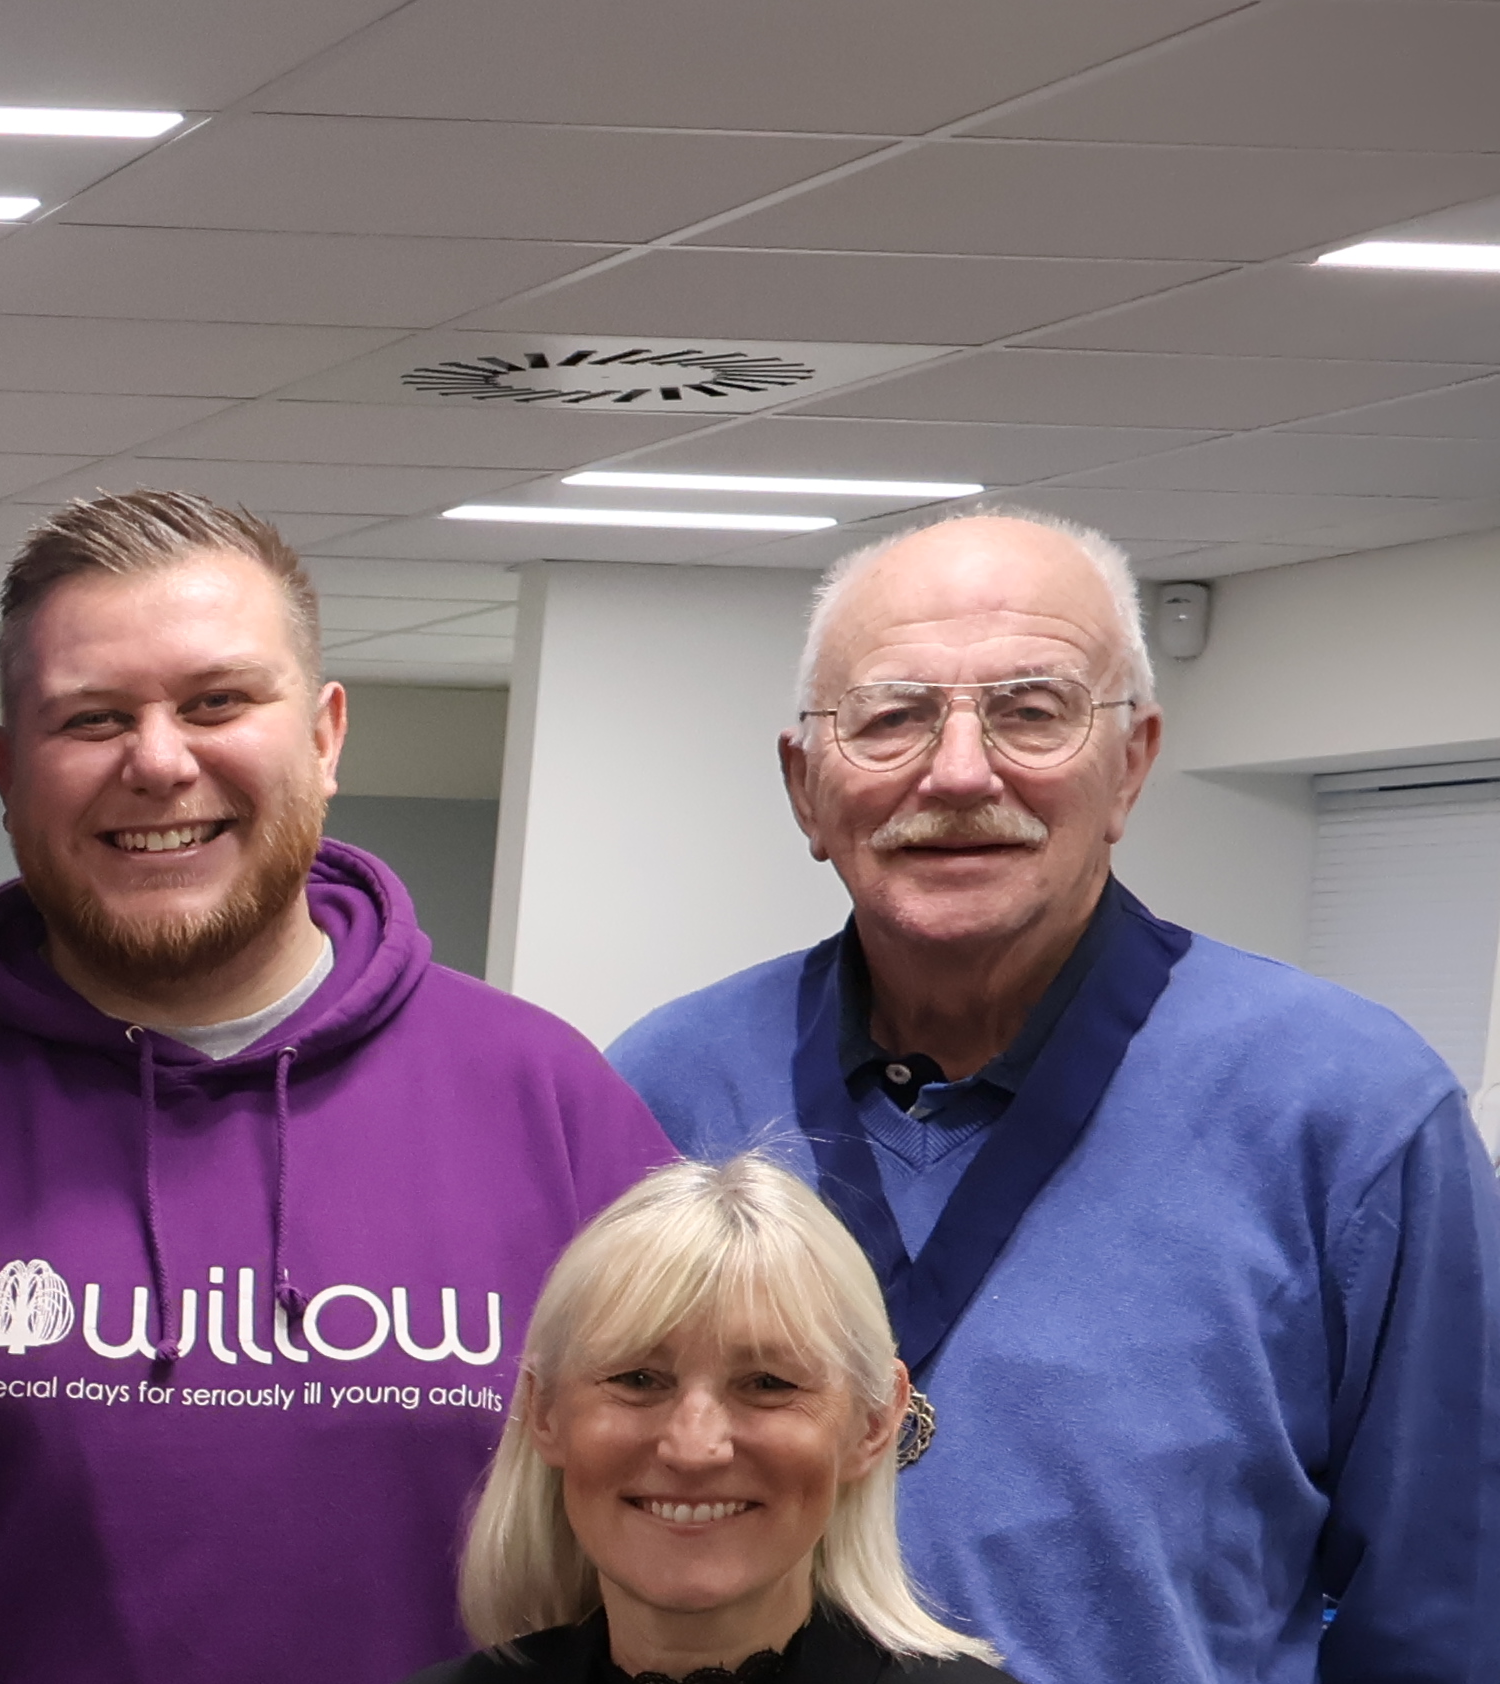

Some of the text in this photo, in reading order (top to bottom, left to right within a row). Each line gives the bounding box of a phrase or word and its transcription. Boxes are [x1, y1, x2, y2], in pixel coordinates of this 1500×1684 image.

[83, 1266, 501, 1366] willow
[66, 1376, 129, 1405] days
[138, 1379, 172, 1404] for
[181, 1382, 295, 1411] seriously
[304, 1381, 322, 1405] ill
[330, 1384, 420, 1410] young
[429, 1384, 503, 1413] adults
